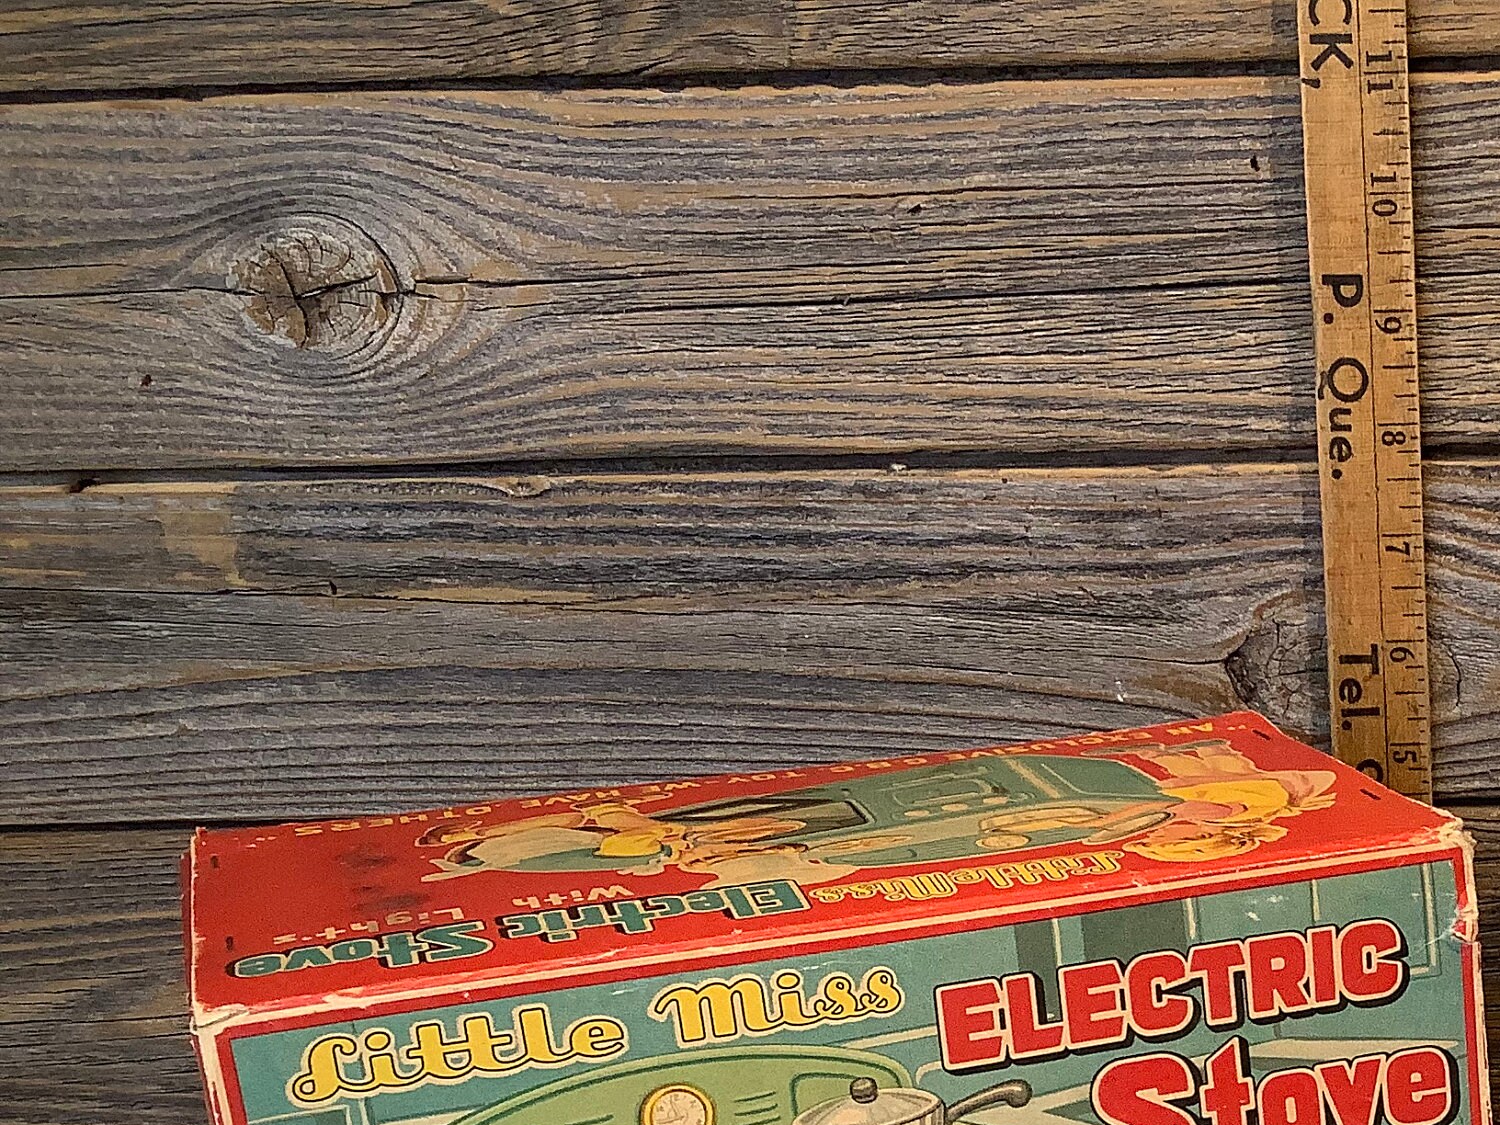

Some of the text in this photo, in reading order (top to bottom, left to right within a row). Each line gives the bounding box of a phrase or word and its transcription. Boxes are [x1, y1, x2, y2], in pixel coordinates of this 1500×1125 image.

[1365, 51, 1393, 94] 11
[1371, 172, 1398, 217] 10
[1322, 274, 1363, 324] P.
[1375, 317, 1401, 334] 9
[1318, 357, 1369, 479] Que.
[1382, 430, 1406, 446] 8
[1385, 541, 1411, 556] 7
[1390, 646, 1415, 664] 6
[1338, 643, 1380, 731] Tel.
[947, 731, 1153, 761] EXCLUSIVE
[1393, 748, 1417, 764] 5
[521, 789, 620, 809] HAVE
[512, 885, 633, 908] With
[808, 850, 1126, 904] Little Miss
[224, 879, 812, 979] Electric Stove
[937, 919, 1408, 1074] ELECTRIC
[290, 968, 904, 1103] Little Miss
